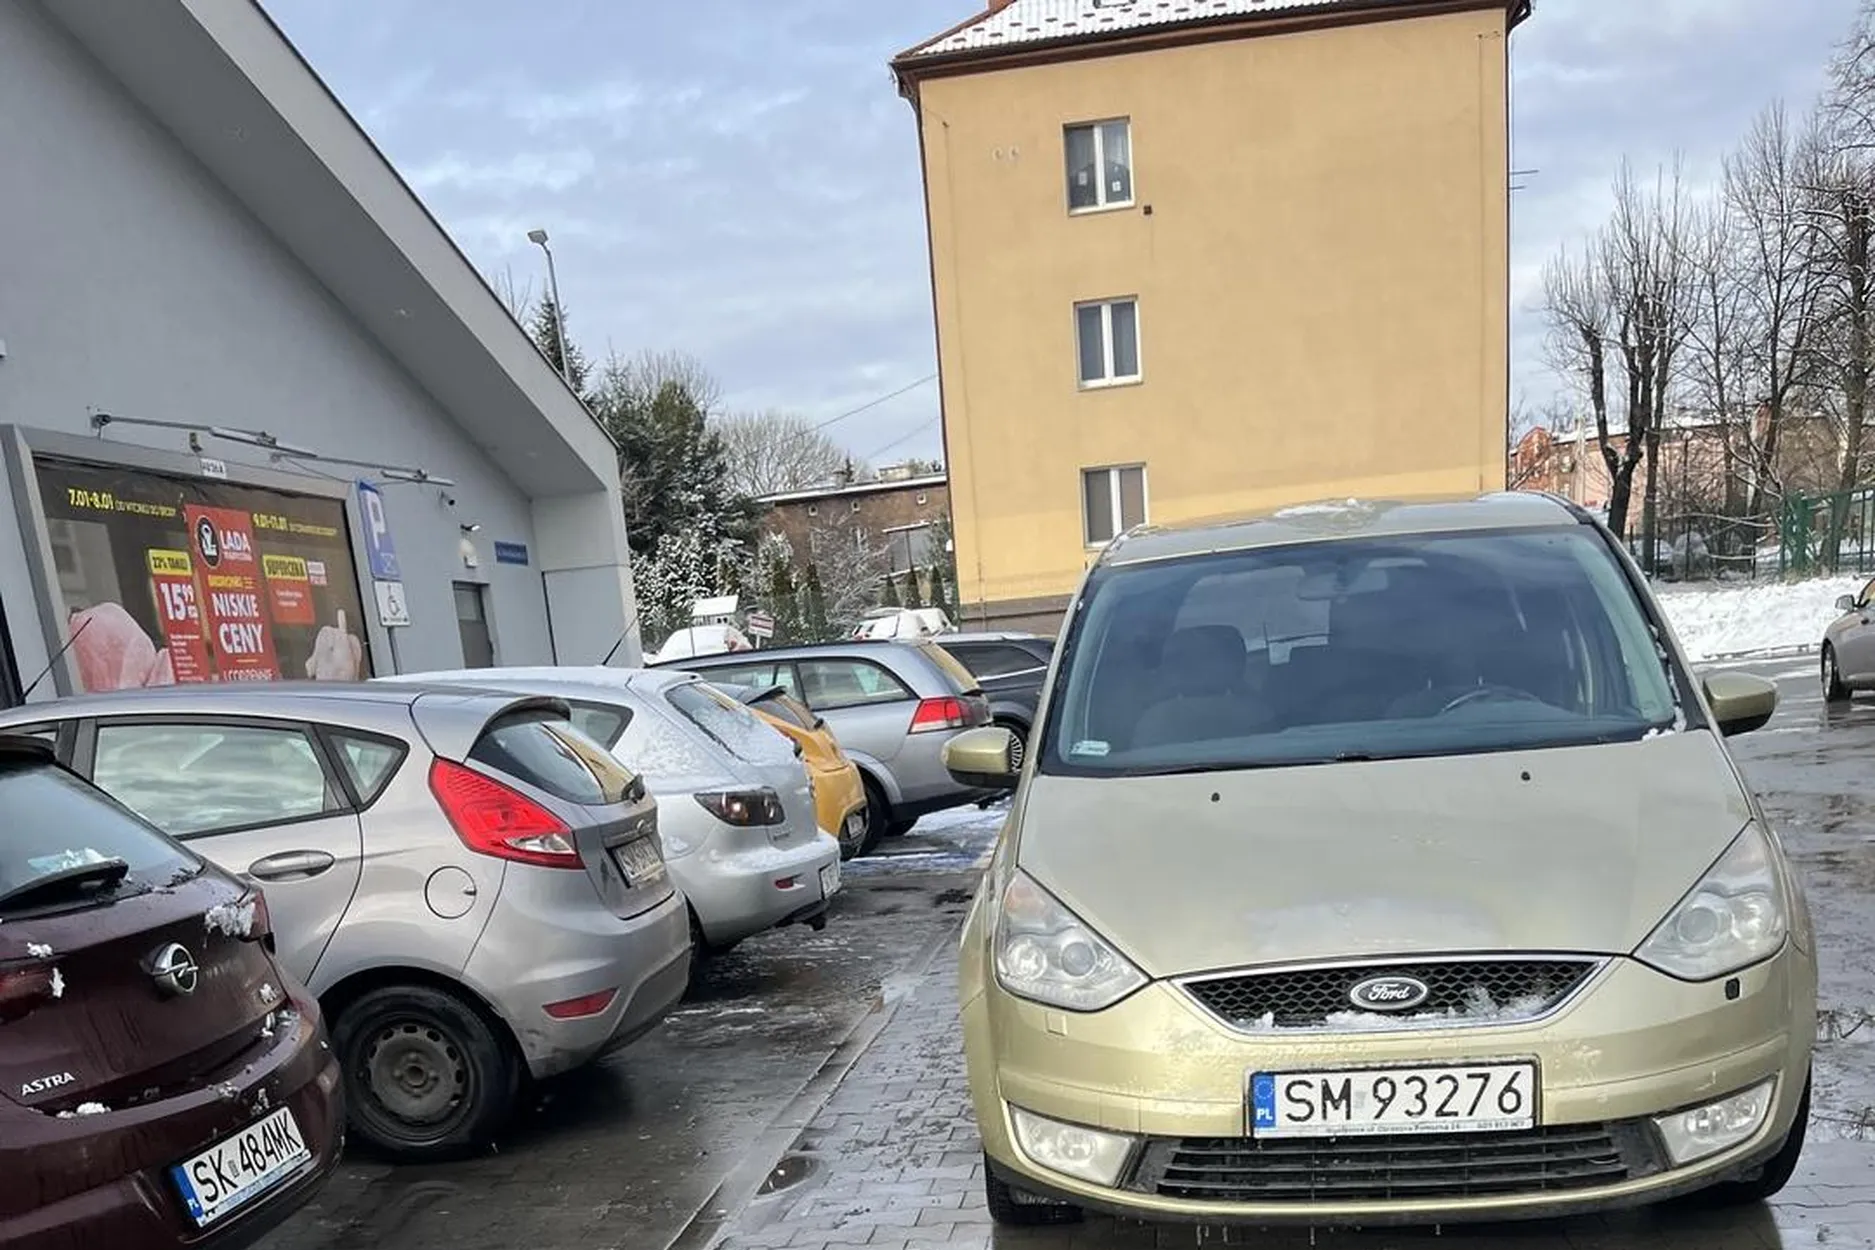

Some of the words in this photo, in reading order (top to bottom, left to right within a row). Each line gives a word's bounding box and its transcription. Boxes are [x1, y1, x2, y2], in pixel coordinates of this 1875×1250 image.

[367, 490, 386, 550] P
[220, 530, 252, 552] LADA
[160, 582, 186, 620] 15
[211, 592, 259, 617] NISKIE
[219, 622, 263, 654] CENY
[1368, 983, 1411, 1001] Ford
[22, 1072, 75, 1097] ASTRA
[1284, 1077, 1352, 1123] SM
[1372, 1071, 1522, 1120] 93276
[1256, 1107, 1274, 1121] PL
[193, 1148, 238, 1203] SK
[238, 1111, 301, 1178] 484MK
